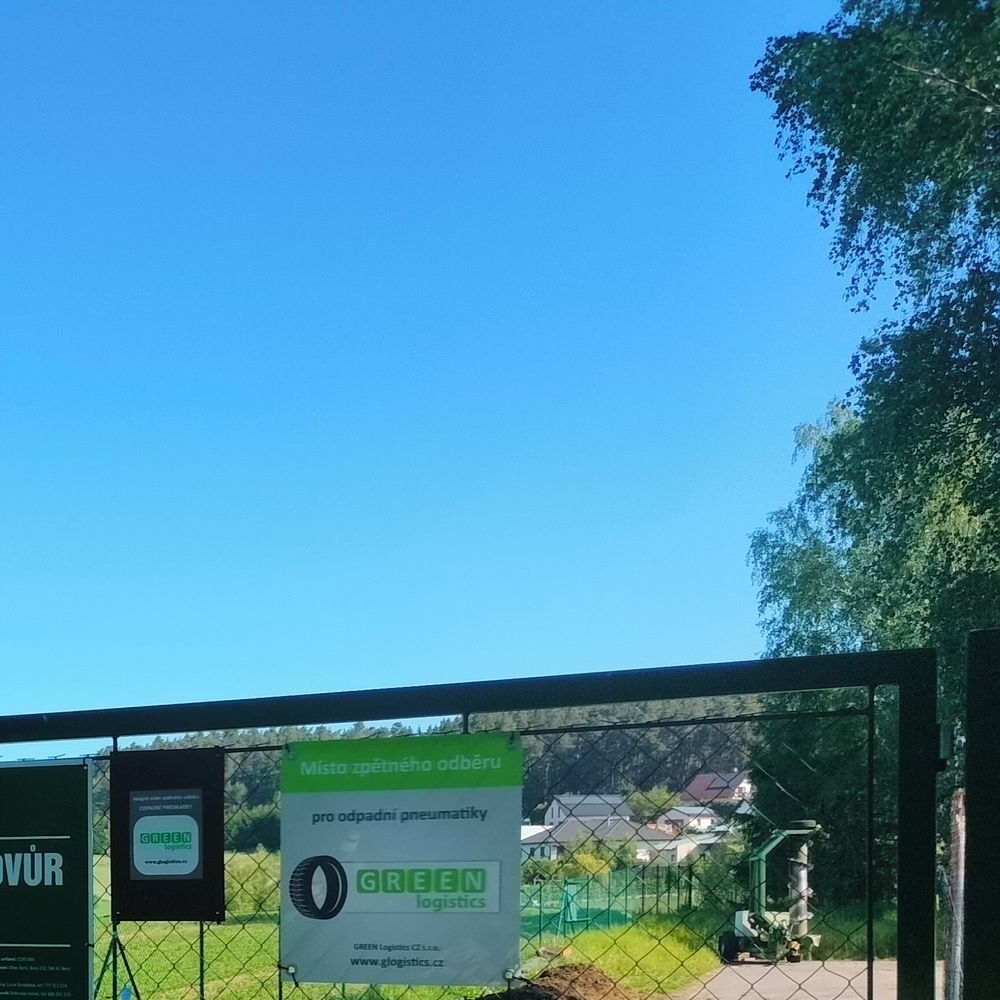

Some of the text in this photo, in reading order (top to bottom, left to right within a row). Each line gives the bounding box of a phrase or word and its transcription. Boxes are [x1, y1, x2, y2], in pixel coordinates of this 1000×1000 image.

[300, 754, 502, 777] Místo zpětného odběru
[311, 806, 488, 825] pro odpadní pneumatiky
[141, 832, 191, 843] GREEN
[358, 870, 484, 892] GREEN
[416, 894, 486, 911] logistics
[379, 943, 410, 952] Logistics
[411, 943, 421, 951] CZ
[350, 957, 444, 968] www.glogistics.cz
